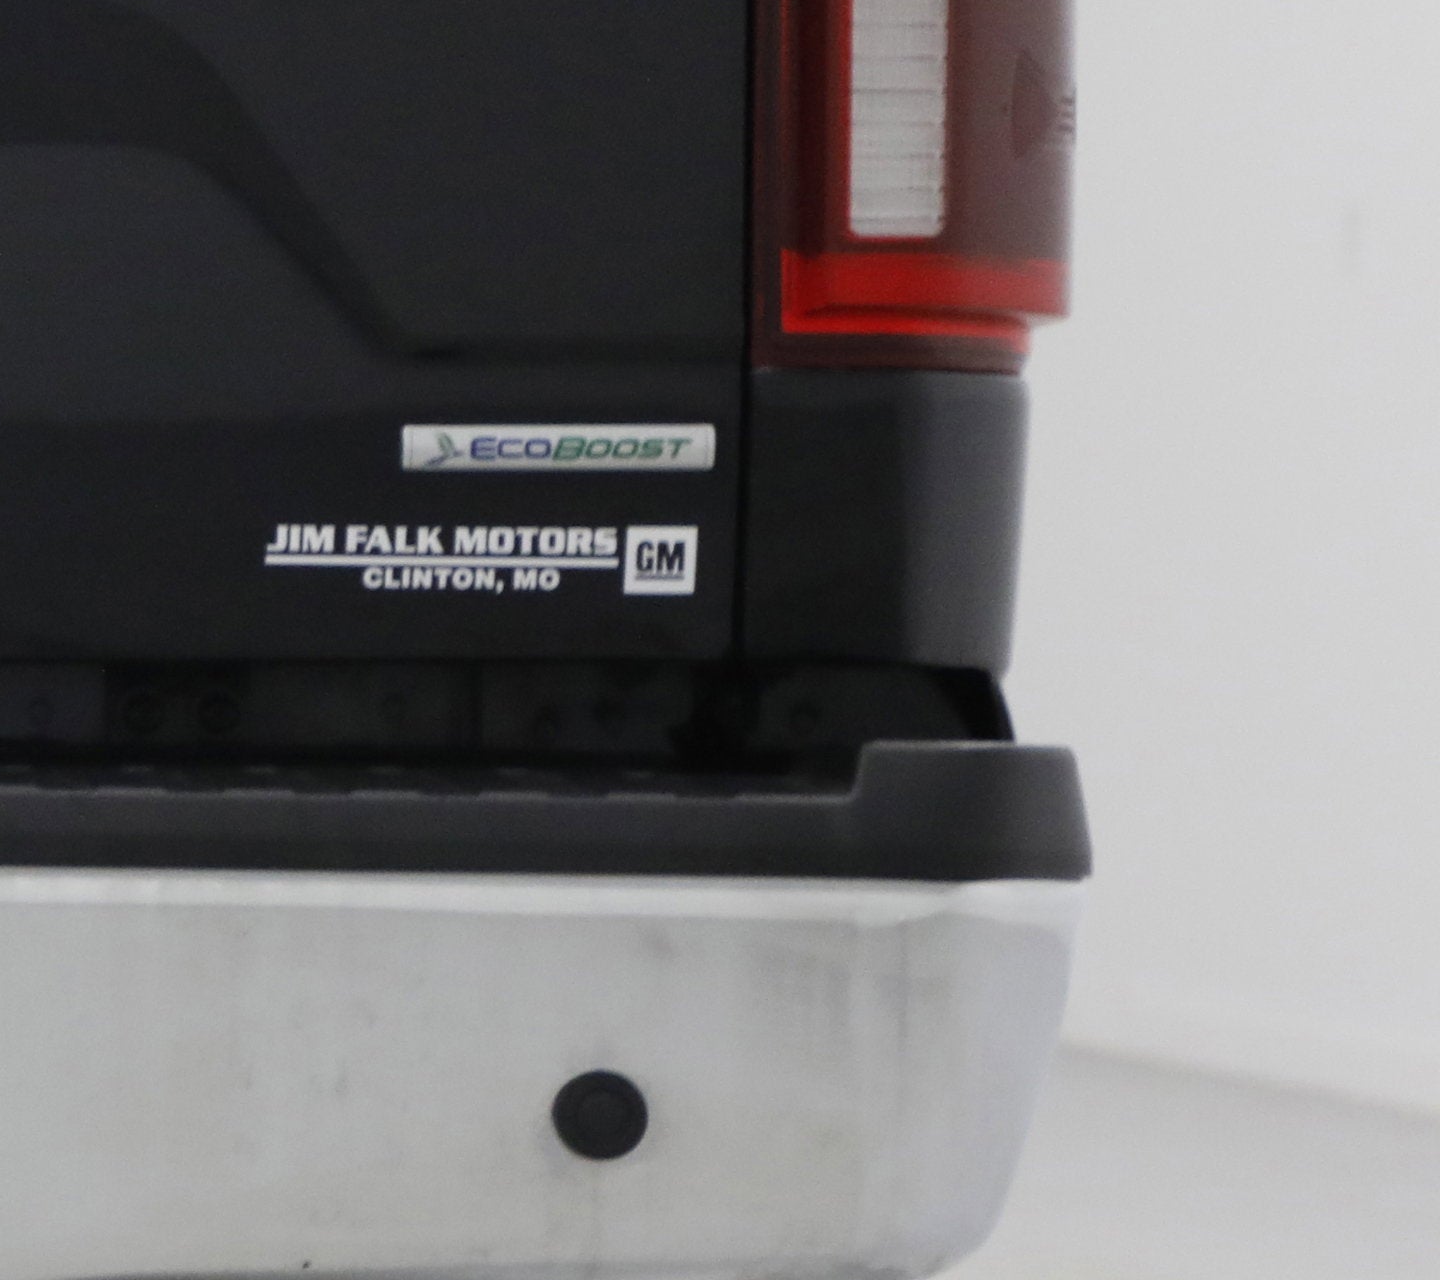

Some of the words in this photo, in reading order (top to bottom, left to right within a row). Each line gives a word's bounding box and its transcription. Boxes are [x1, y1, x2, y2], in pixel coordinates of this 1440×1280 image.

[266, 523, 336, 554] JIM
[344, 524, 444, 555] FALK
[453, 525, 618, 556] MOTORS
[636, 541, 685, 572] GM
[362, 566, 509, 594] CLINTON,
[512, 567, 561, 591] MO
